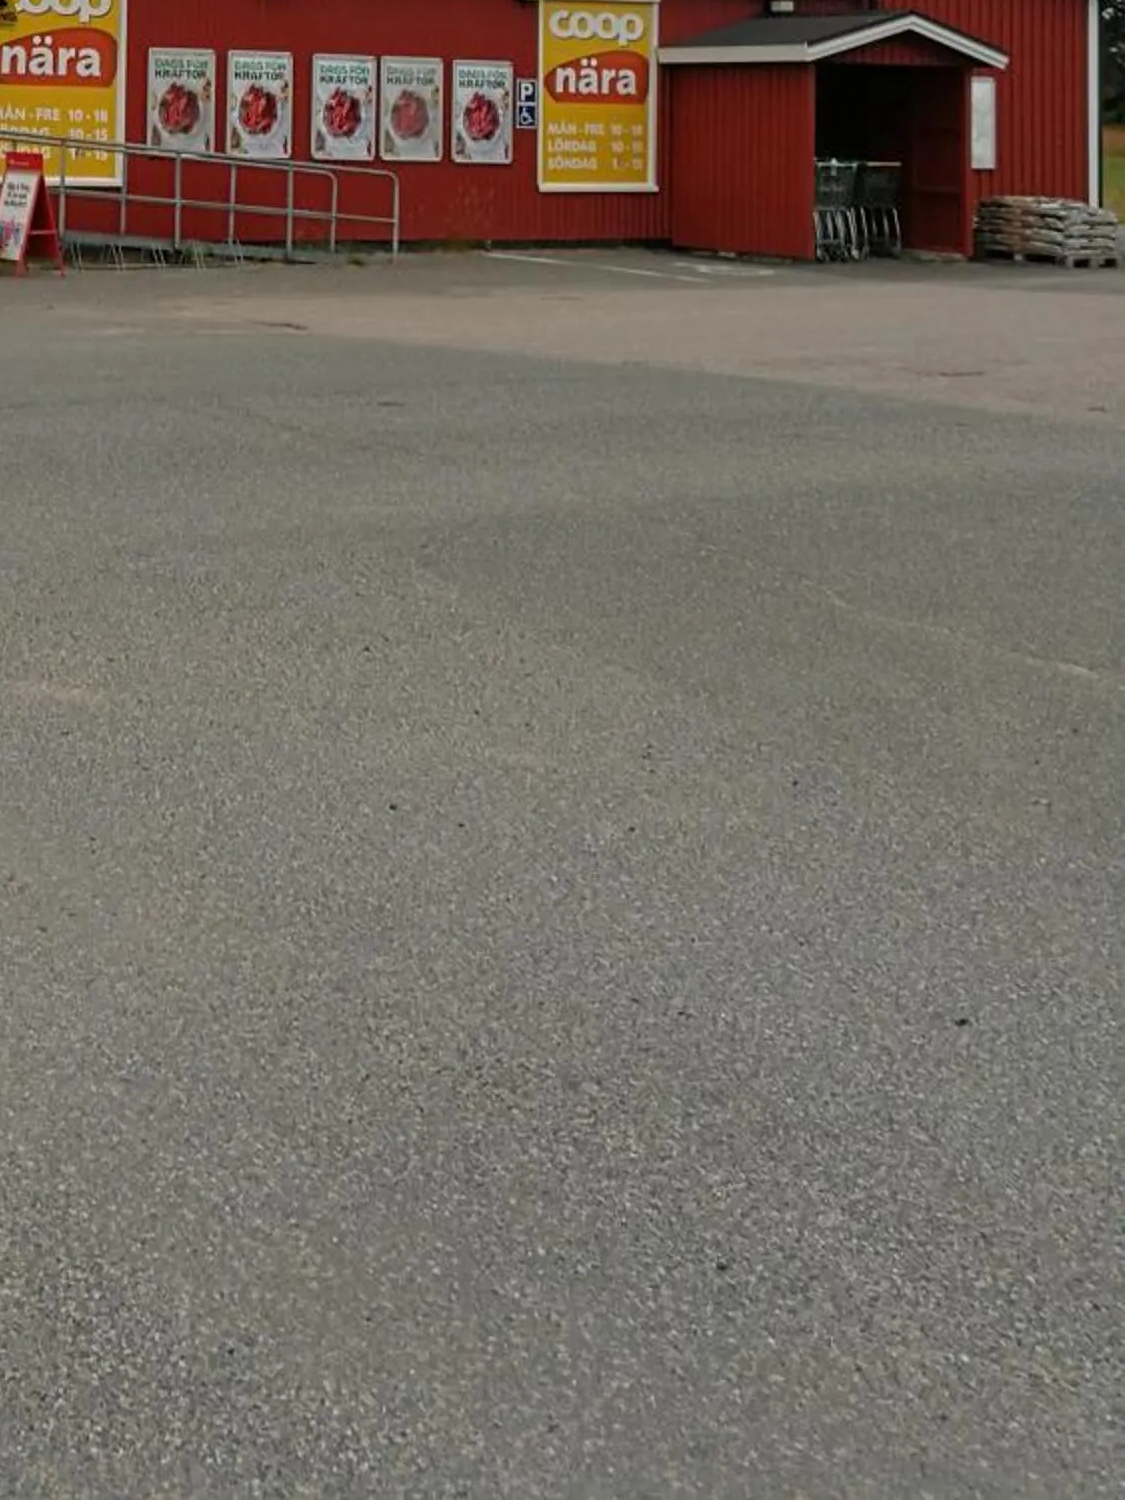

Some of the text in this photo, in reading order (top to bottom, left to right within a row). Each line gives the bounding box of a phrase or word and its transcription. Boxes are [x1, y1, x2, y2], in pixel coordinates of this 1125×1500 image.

[549, 9, 644, 46] coop
[1, 36, 101, 77] nära
[521, 83, 533, 100] P
[555, 58, 636, 95] nära
[36, 107, 60, 122] FRE
[69, 108, 84, 122] 10
